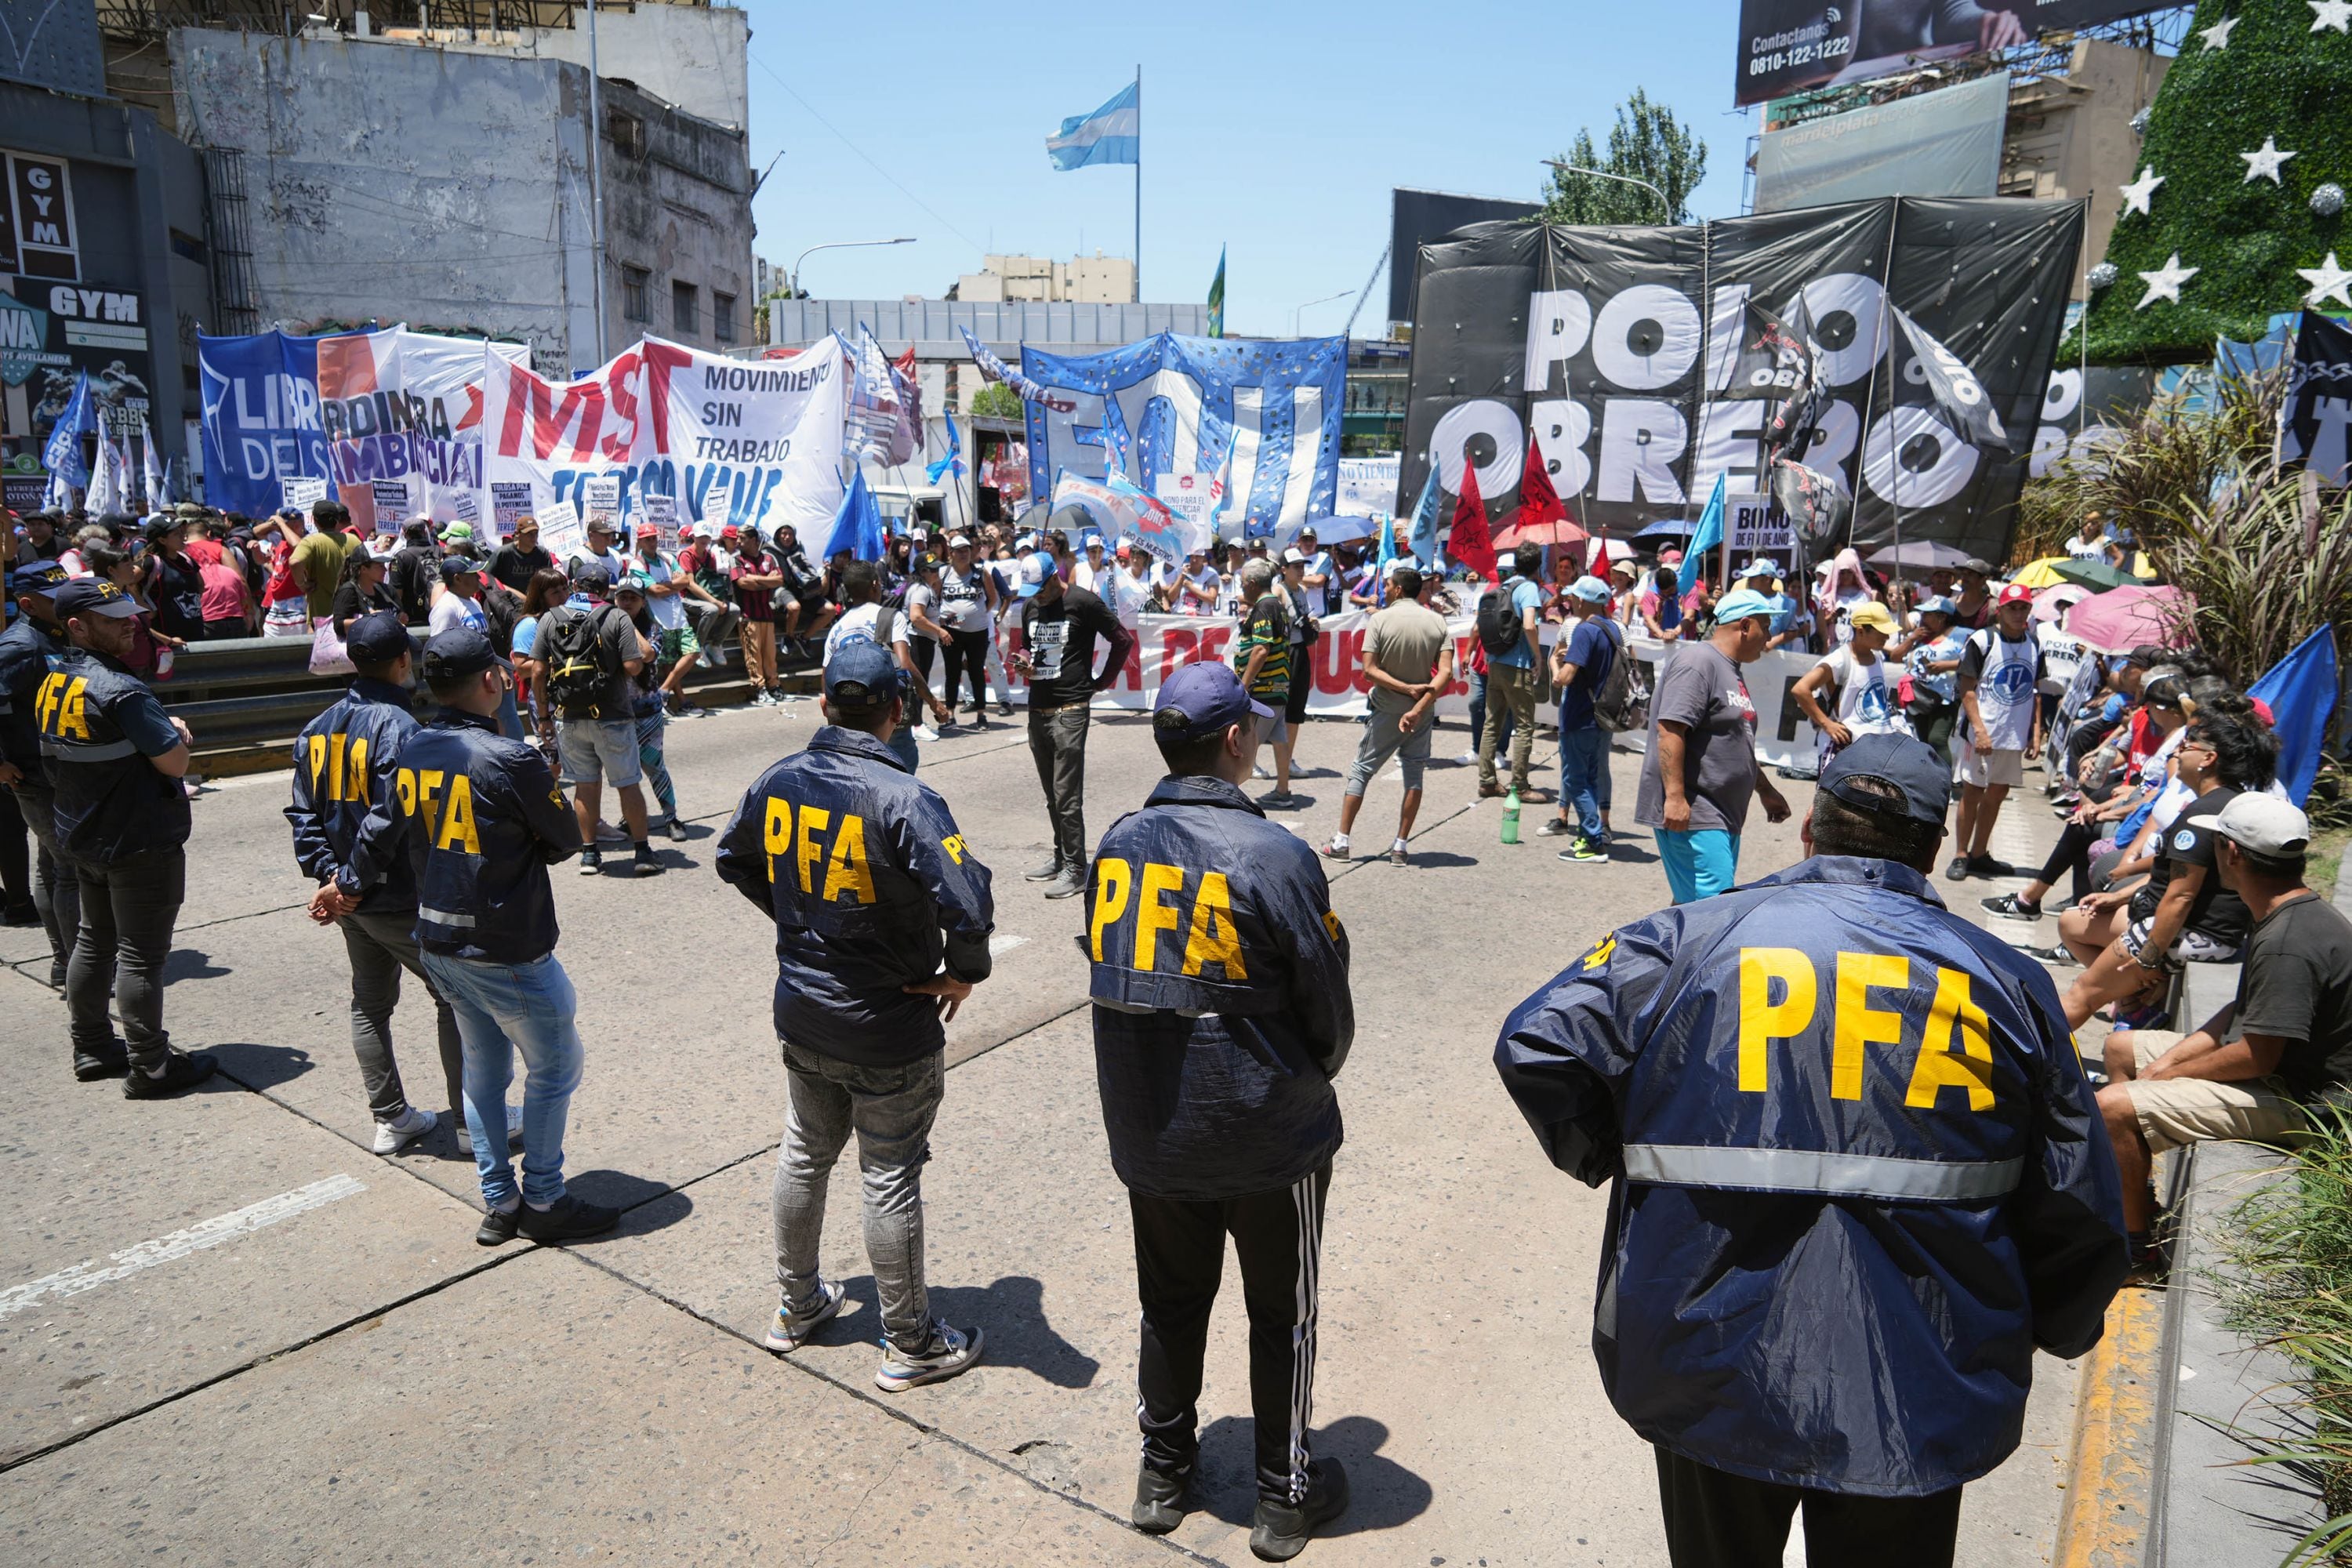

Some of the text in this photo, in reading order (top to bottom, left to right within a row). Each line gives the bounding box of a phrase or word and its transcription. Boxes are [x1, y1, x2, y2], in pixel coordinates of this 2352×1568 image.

[1751, 21, 1830, 54] Contactanos
[1750, 36, 1850, 76] 0810-122-1222
[1780, 113, 1879, 148] mardelplata
[27, 167, 61, 245] GYM
[49, 285, 139, 323] GYM
[1524, 273, 1887, 392] POLO
[16, 352, 71, 365] AVELLANEDA
[234, 373, 321, 430] LIBR
[498, 343, 693, 463] MST
[702, 401, 742, 428] SIN
[696, 436, 790, 463] TRABAJO
[1428, 399, 1980, 508] OBRERO
[378, 521, 397, 530] TERESA
[1171, 504, 1201, 514] OTENCIAR
[1737, 507, 1791, 530] BONO
[1145, 539, 1173, 562] NUESTRO
[1735, 532, 1746, 546] DE
[1762, 532, 1772, 546] DE
[1773, 530, 1790, 546] AÑO
[2006, 666, 2024, 685] 17
[397, 767, 481, 855] PFA
[764, 795, 877, 904] PFA
[1091, 857, 1249, 980] PFA
[1737, 946, 1995, 1112] PFA
